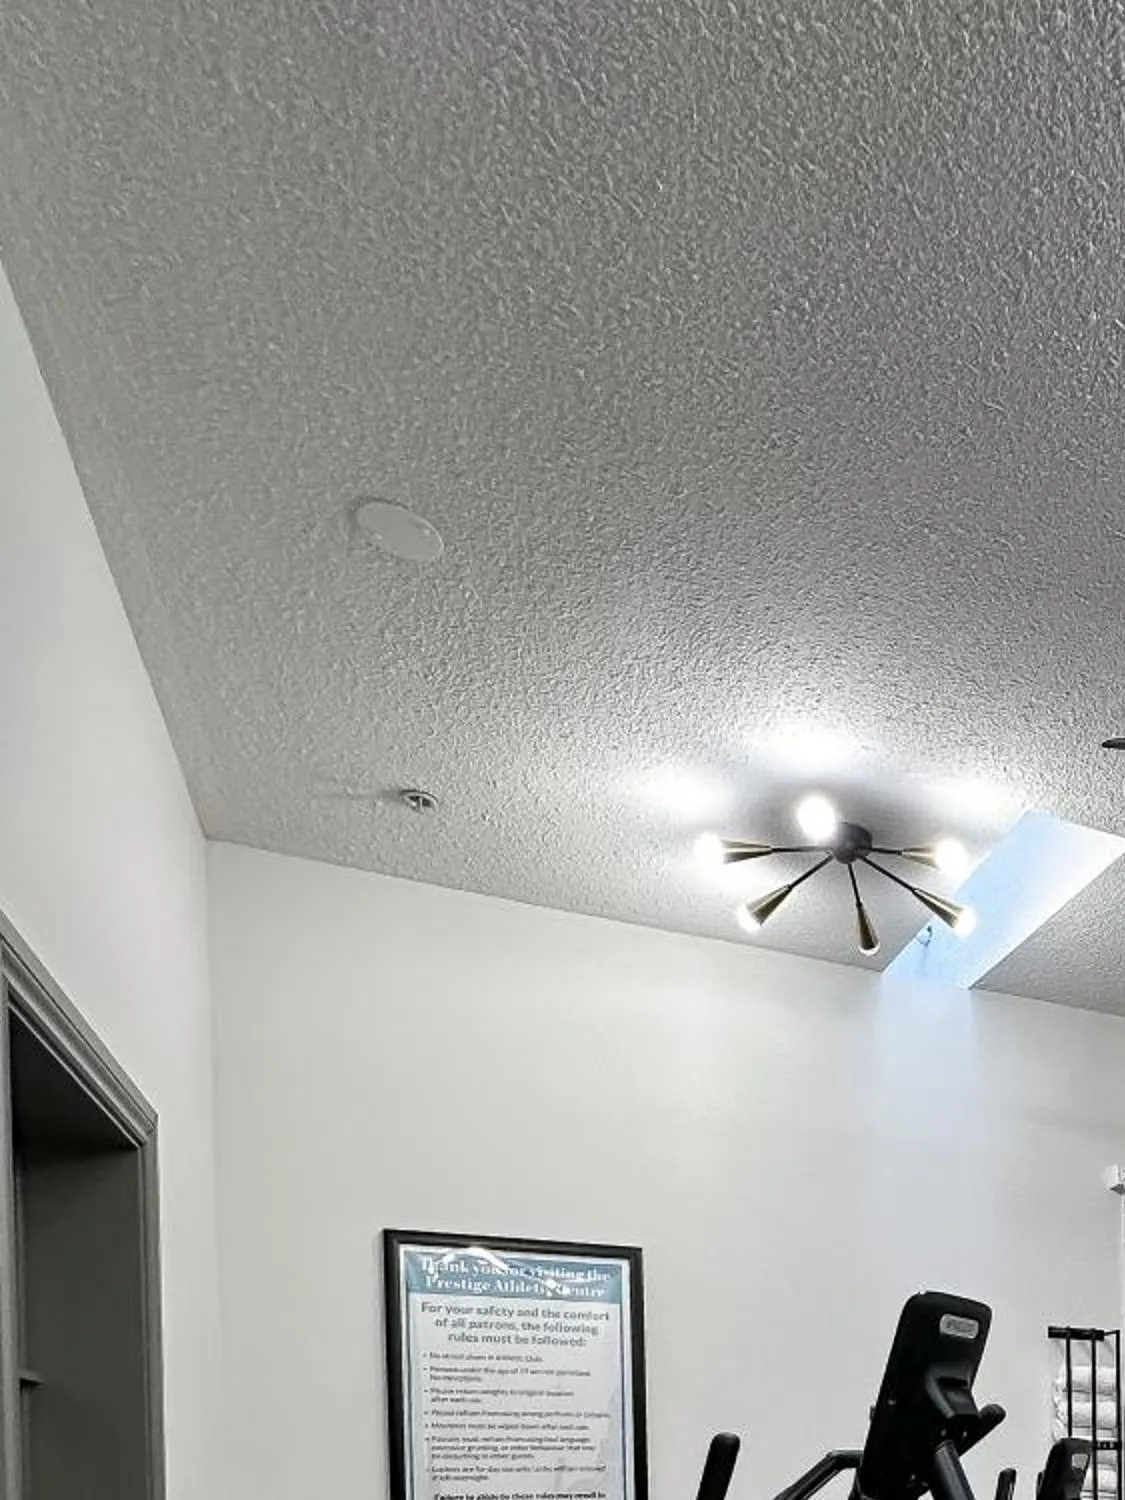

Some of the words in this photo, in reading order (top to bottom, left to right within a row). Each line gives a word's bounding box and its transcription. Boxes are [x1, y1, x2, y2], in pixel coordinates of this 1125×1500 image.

[426, 1275, 490, 1294] Prestige
[421, 1301, 442, 1312] For
[445, 1304, 474, 1316] your
[476, 1304, 514, 1318] safety
[516, 1307, 538, 1317] and
[541, 1308, 561, 1319] the
[563, 1309, 609, 1321] comfort
[435, 1317, 448, 1328] of
[451, 1317, 466, 1328] all
[521, 1321, 541, 1332] the
[543, 1321, 599, 1336] following
[448, 1332, 479, 1343] rules
[481, 1335, 512, 1345] must
